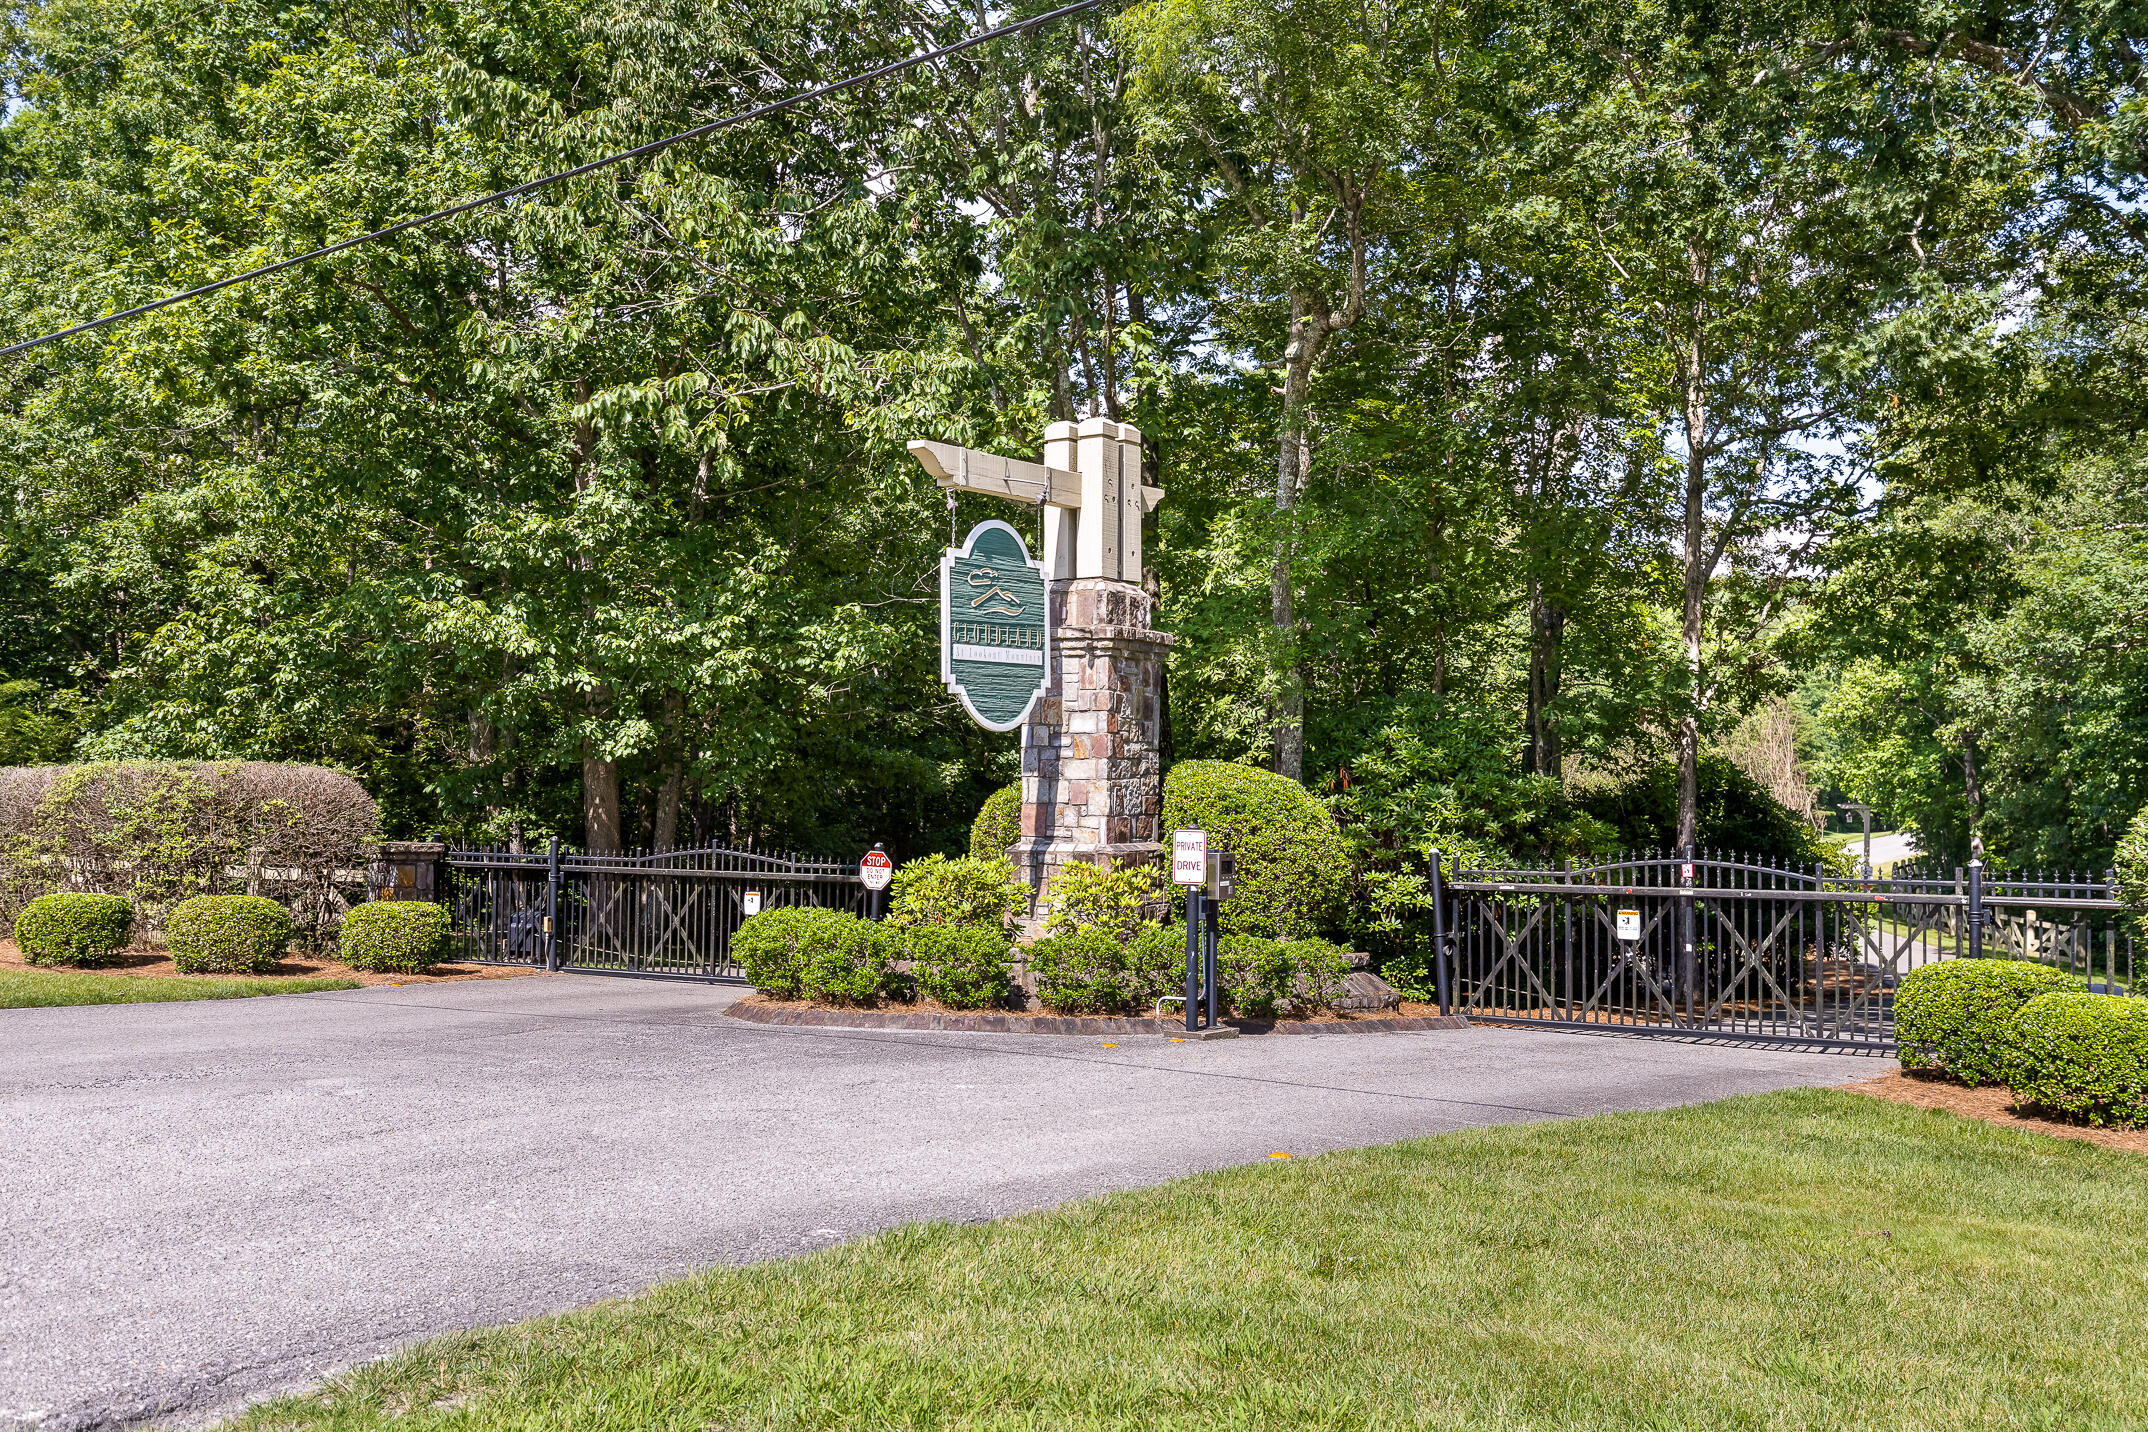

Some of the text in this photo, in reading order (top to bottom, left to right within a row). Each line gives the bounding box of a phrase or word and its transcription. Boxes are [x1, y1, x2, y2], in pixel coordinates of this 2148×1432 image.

[953, 622, 1042, 648] CLOUDLAND
[1176, 842, 1202, 852] PRIVATE
[866, 856, 886, 866] STOP
[1177, 861, 1201, 871] DRIVE
